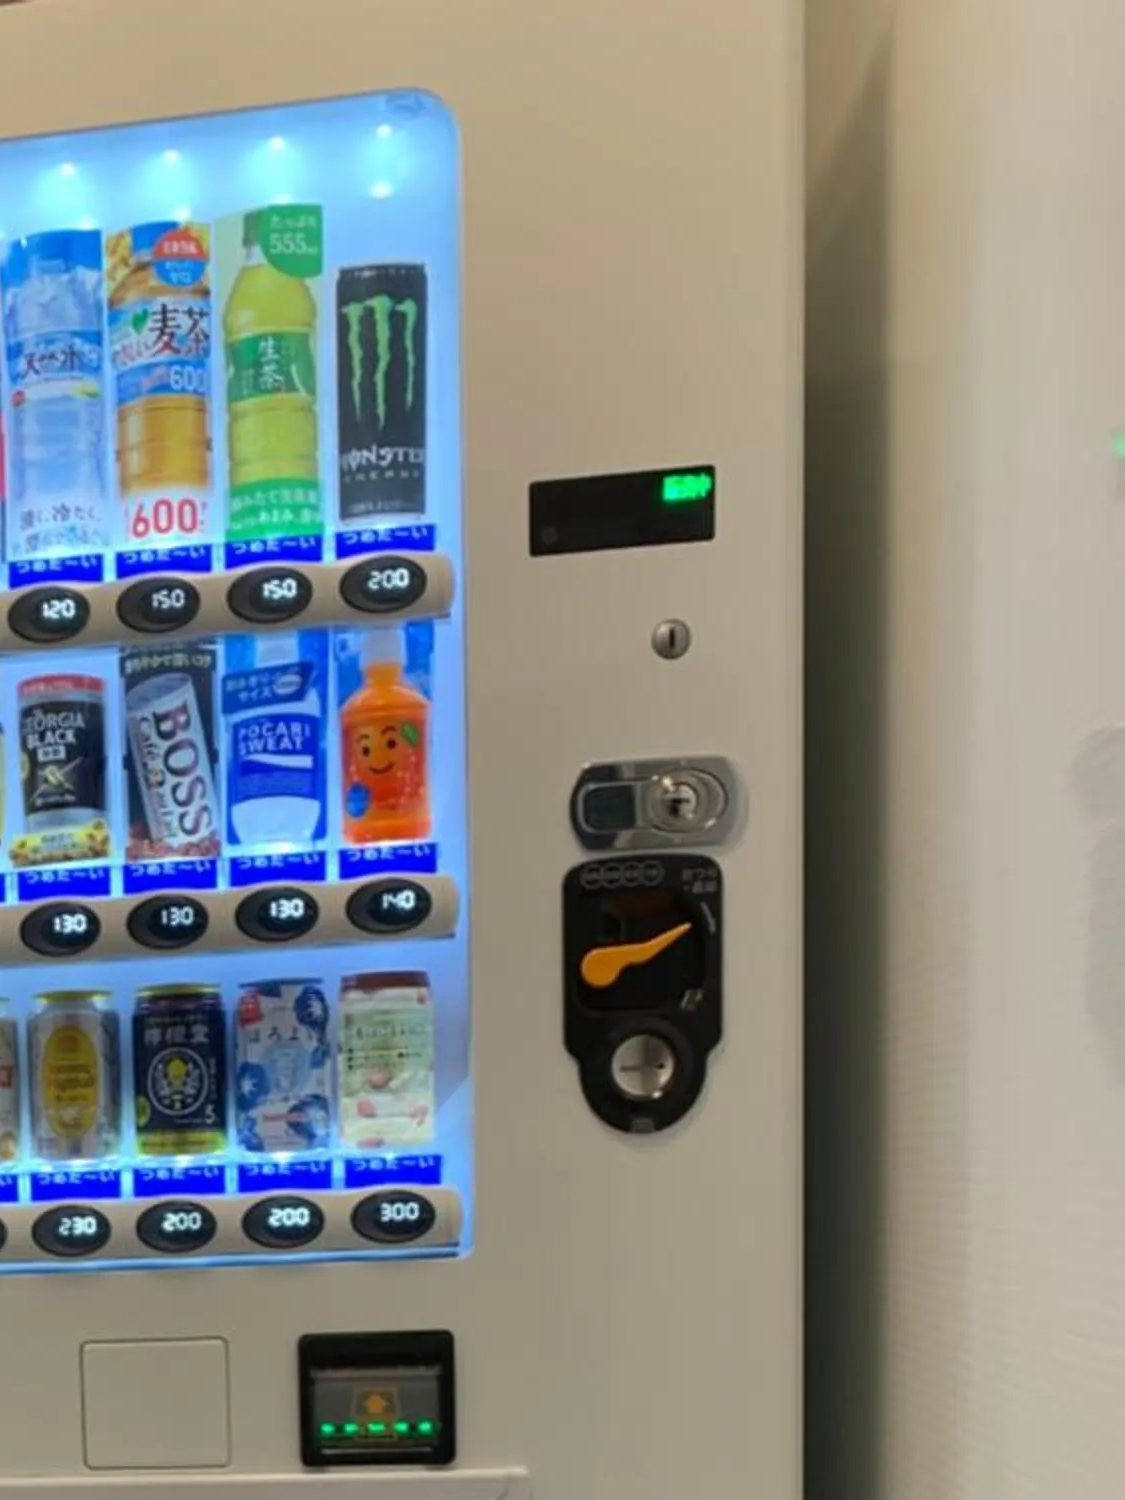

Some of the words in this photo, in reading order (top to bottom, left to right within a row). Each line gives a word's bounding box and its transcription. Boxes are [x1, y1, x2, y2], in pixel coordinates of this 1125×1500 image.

[132, 499, 198, 538] 600
[368, 567, 410, 590] 200
[152, 589, 185, 609] 150
[262, 578, 298, 600] 150
[42, 598, 76, 619] 120
[152, 702, 213, 837] BOSS
[270, 898, 304, 919] 130
[382, 890, 415, 910] 140
[54, 913, 87, 933] 130
[162, 906, 194, 926] 130
[162, 1211, 202, 1232] 200
[268, 1207, 310, 1227] 200
[381, 1202, 419, 1221] 300
[58, 1216, 97, 1235] 230
